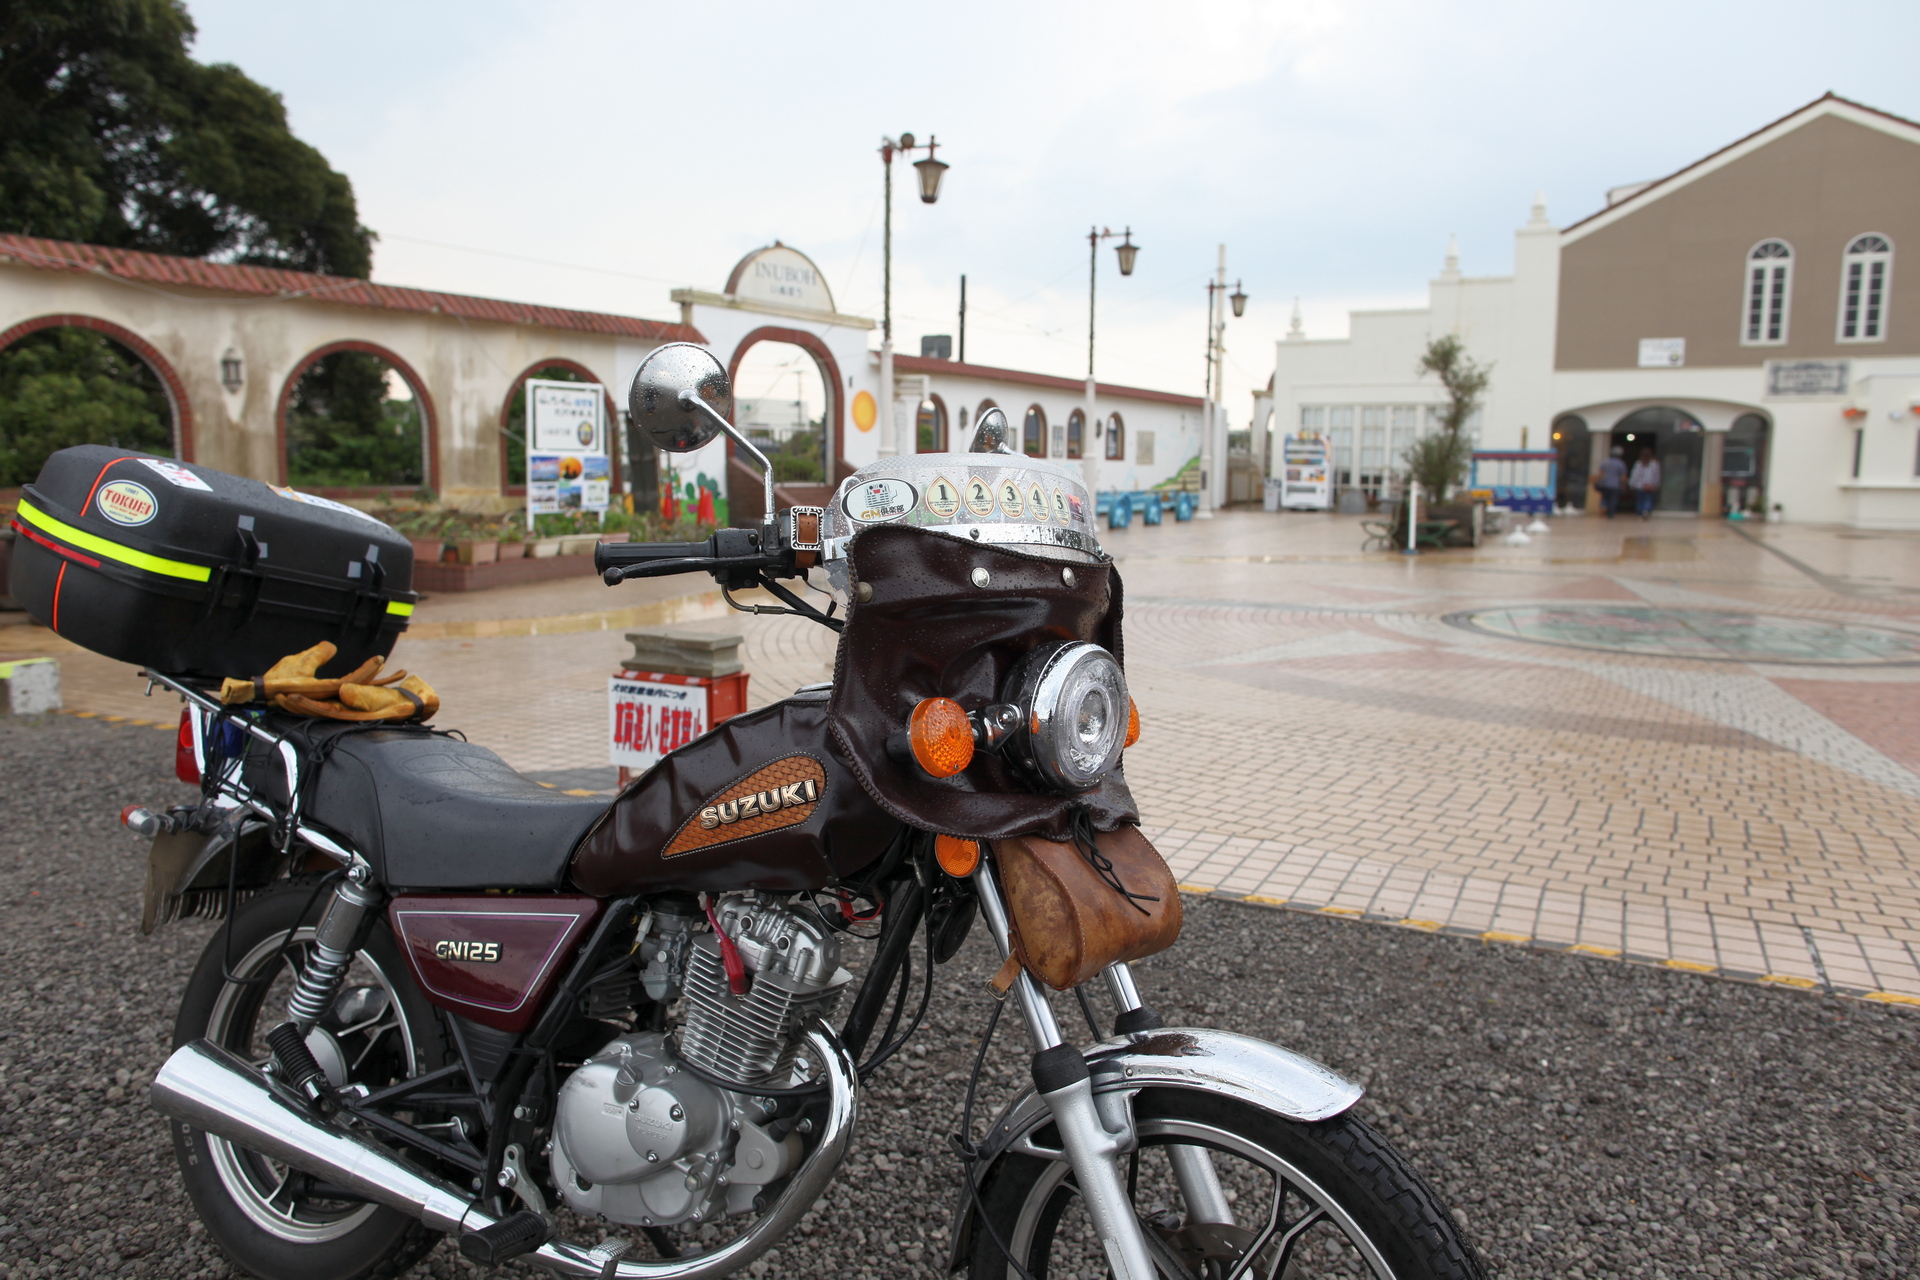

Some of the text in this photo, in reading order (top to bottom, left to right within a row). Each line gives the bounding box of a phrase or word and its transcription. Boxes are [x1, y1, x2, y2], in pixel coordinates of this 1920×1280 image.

[754, 261, 817, 286] INUBOH
[938, 484, 949, 500] 1
[972, 483, 984, 500] 2
[1005, 485, 1016, 502] 3
[1032, 489, 1042, 505] 4
[104, 489, 152, 515] TOKUEI
[1056, 494, 1064, 510] 5
[700, 780, 817, 828] SUZUKI
[435, 940, 499, 962] GN125
[633, 1113, 674, 1131] SUZUKI
